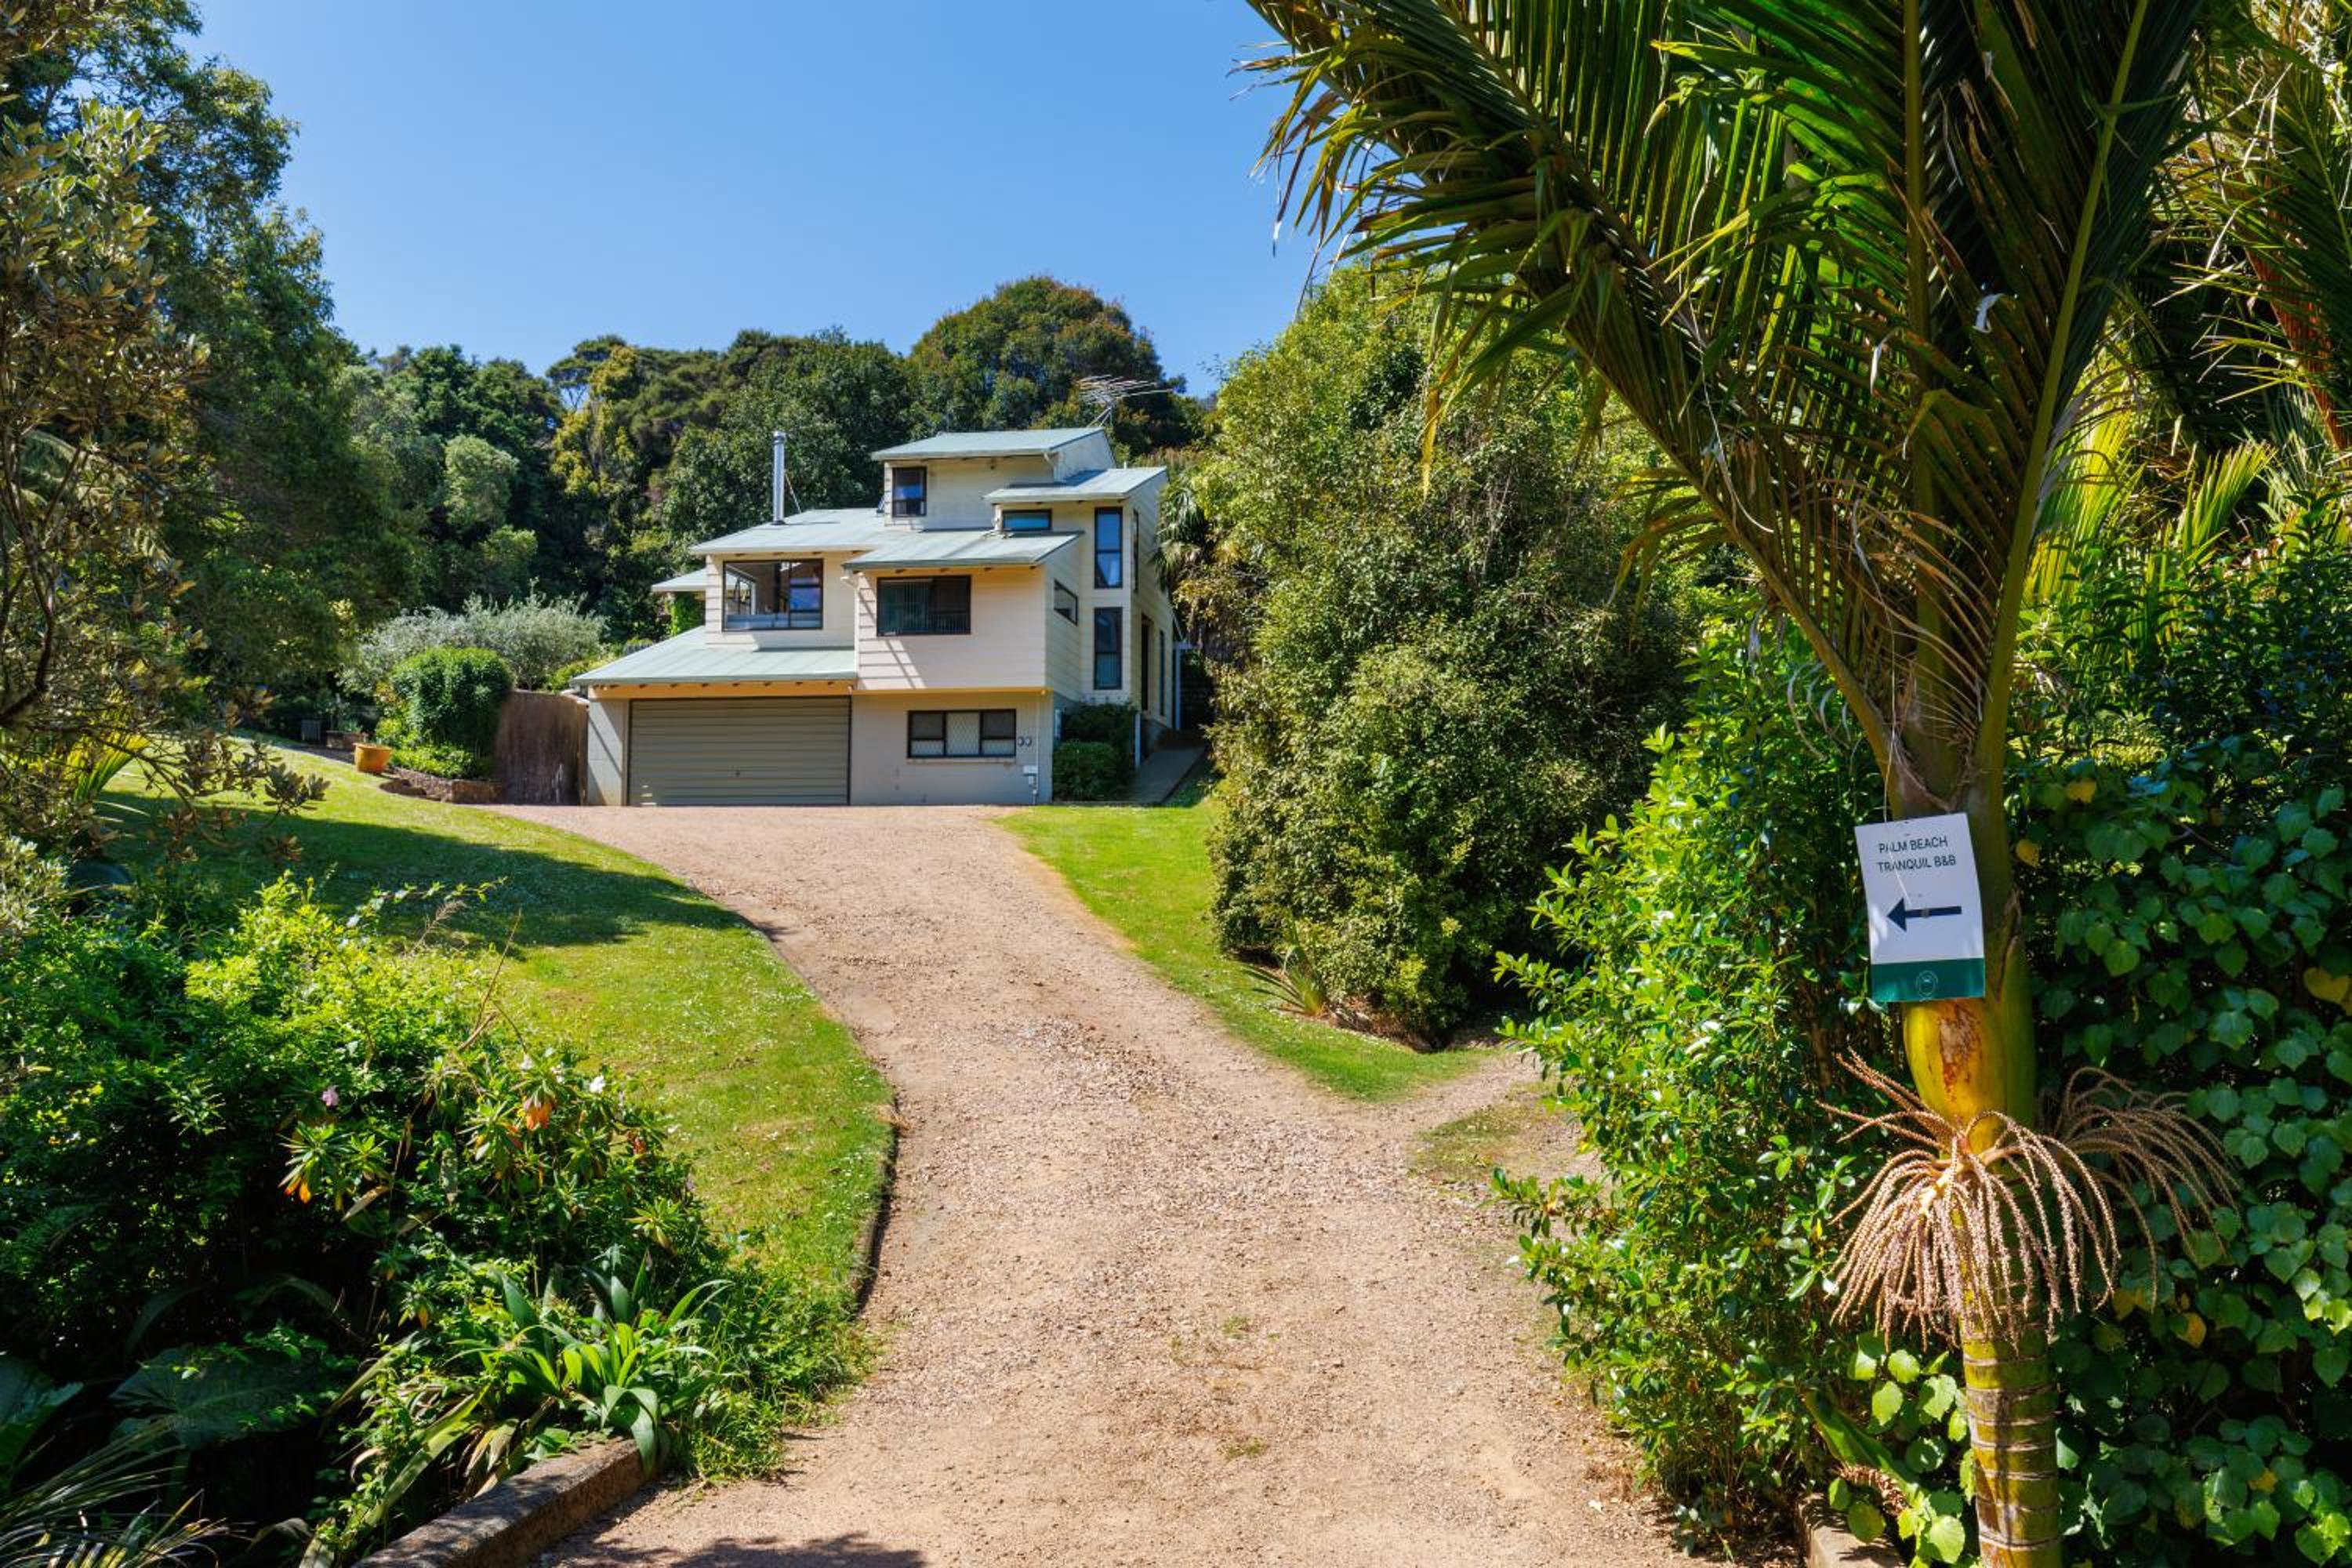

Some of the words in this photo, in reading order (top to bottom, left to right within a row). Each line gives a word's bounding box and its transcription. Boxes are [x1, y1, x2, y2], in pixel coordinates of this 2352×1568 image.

[1878, 841, 1907, 853] PALM
[1910, 836, 1949, 851] BEACH
[1877, 858, 1932, 872] TRANQUIL
[1933, 855, 1957, 867] B&B
